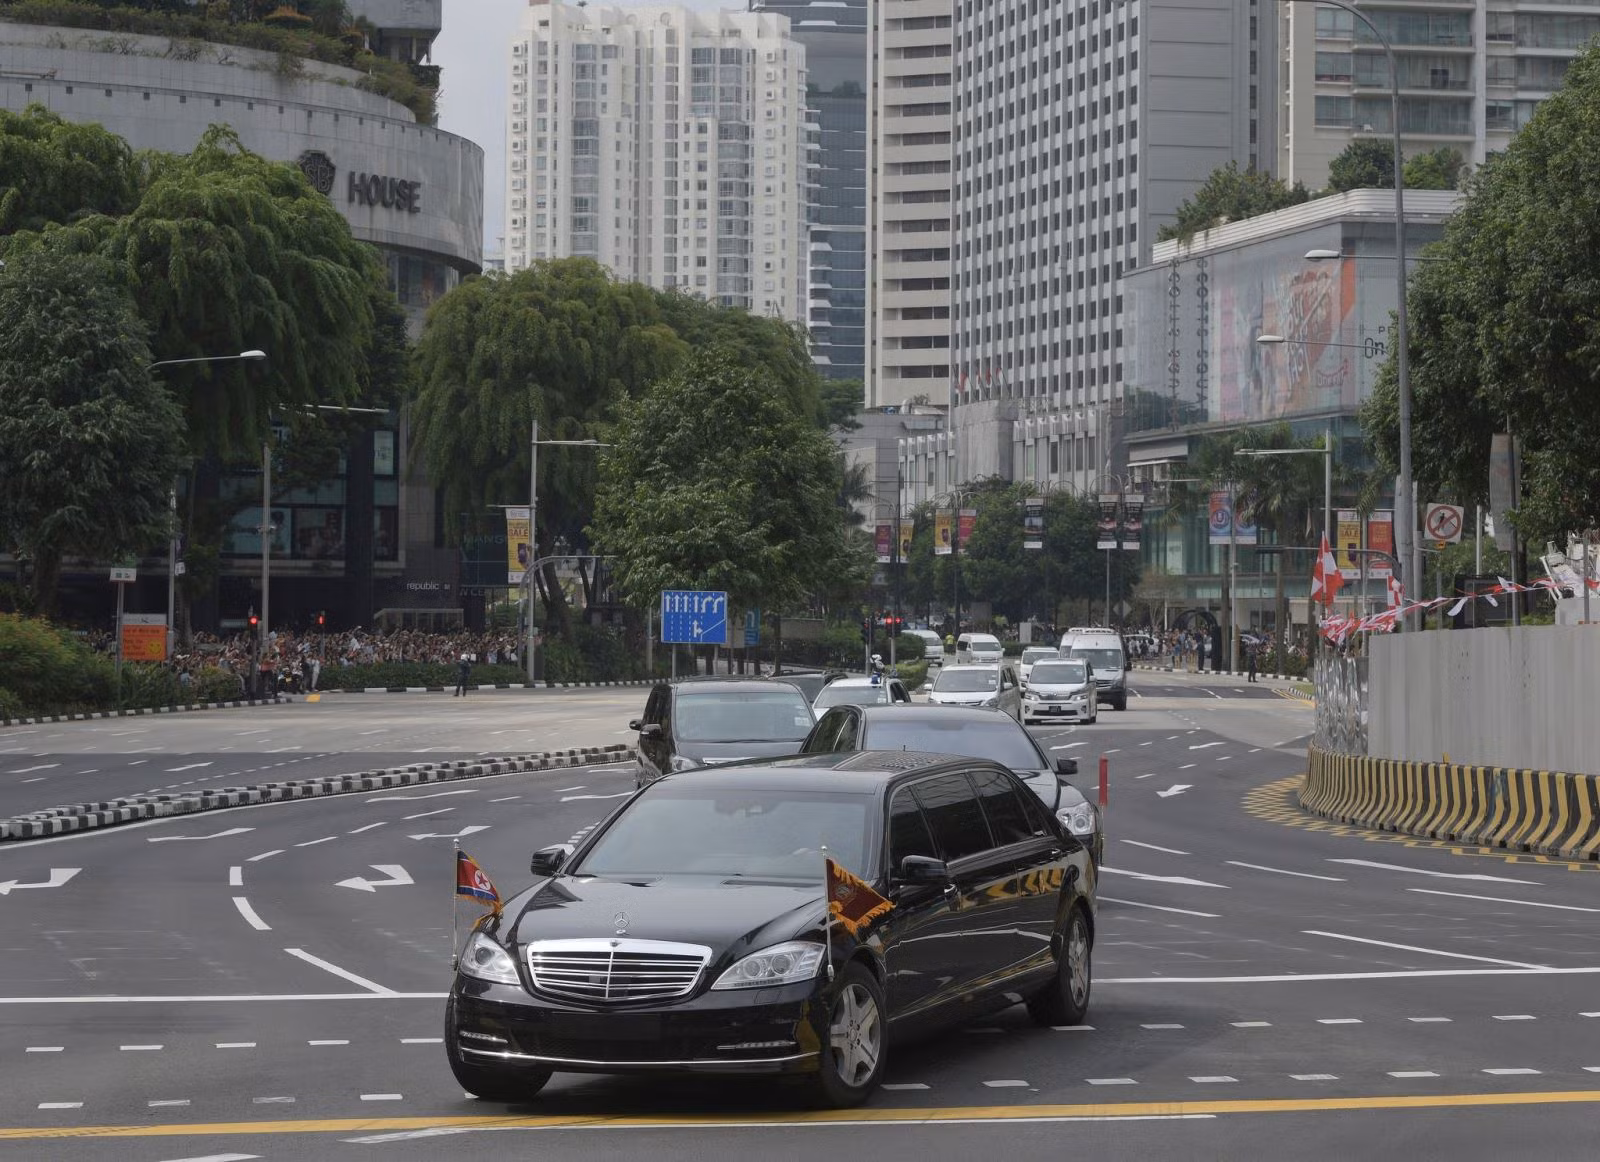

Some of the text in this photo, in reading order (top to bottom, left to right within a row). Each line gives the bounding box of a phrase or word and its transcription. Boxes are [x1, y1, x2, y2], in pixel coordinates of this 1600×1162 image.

[348, 171, 421, 214] HOUSE
[508, 528, 529, 538] SALE
[406, 581, 440, 592] republic
